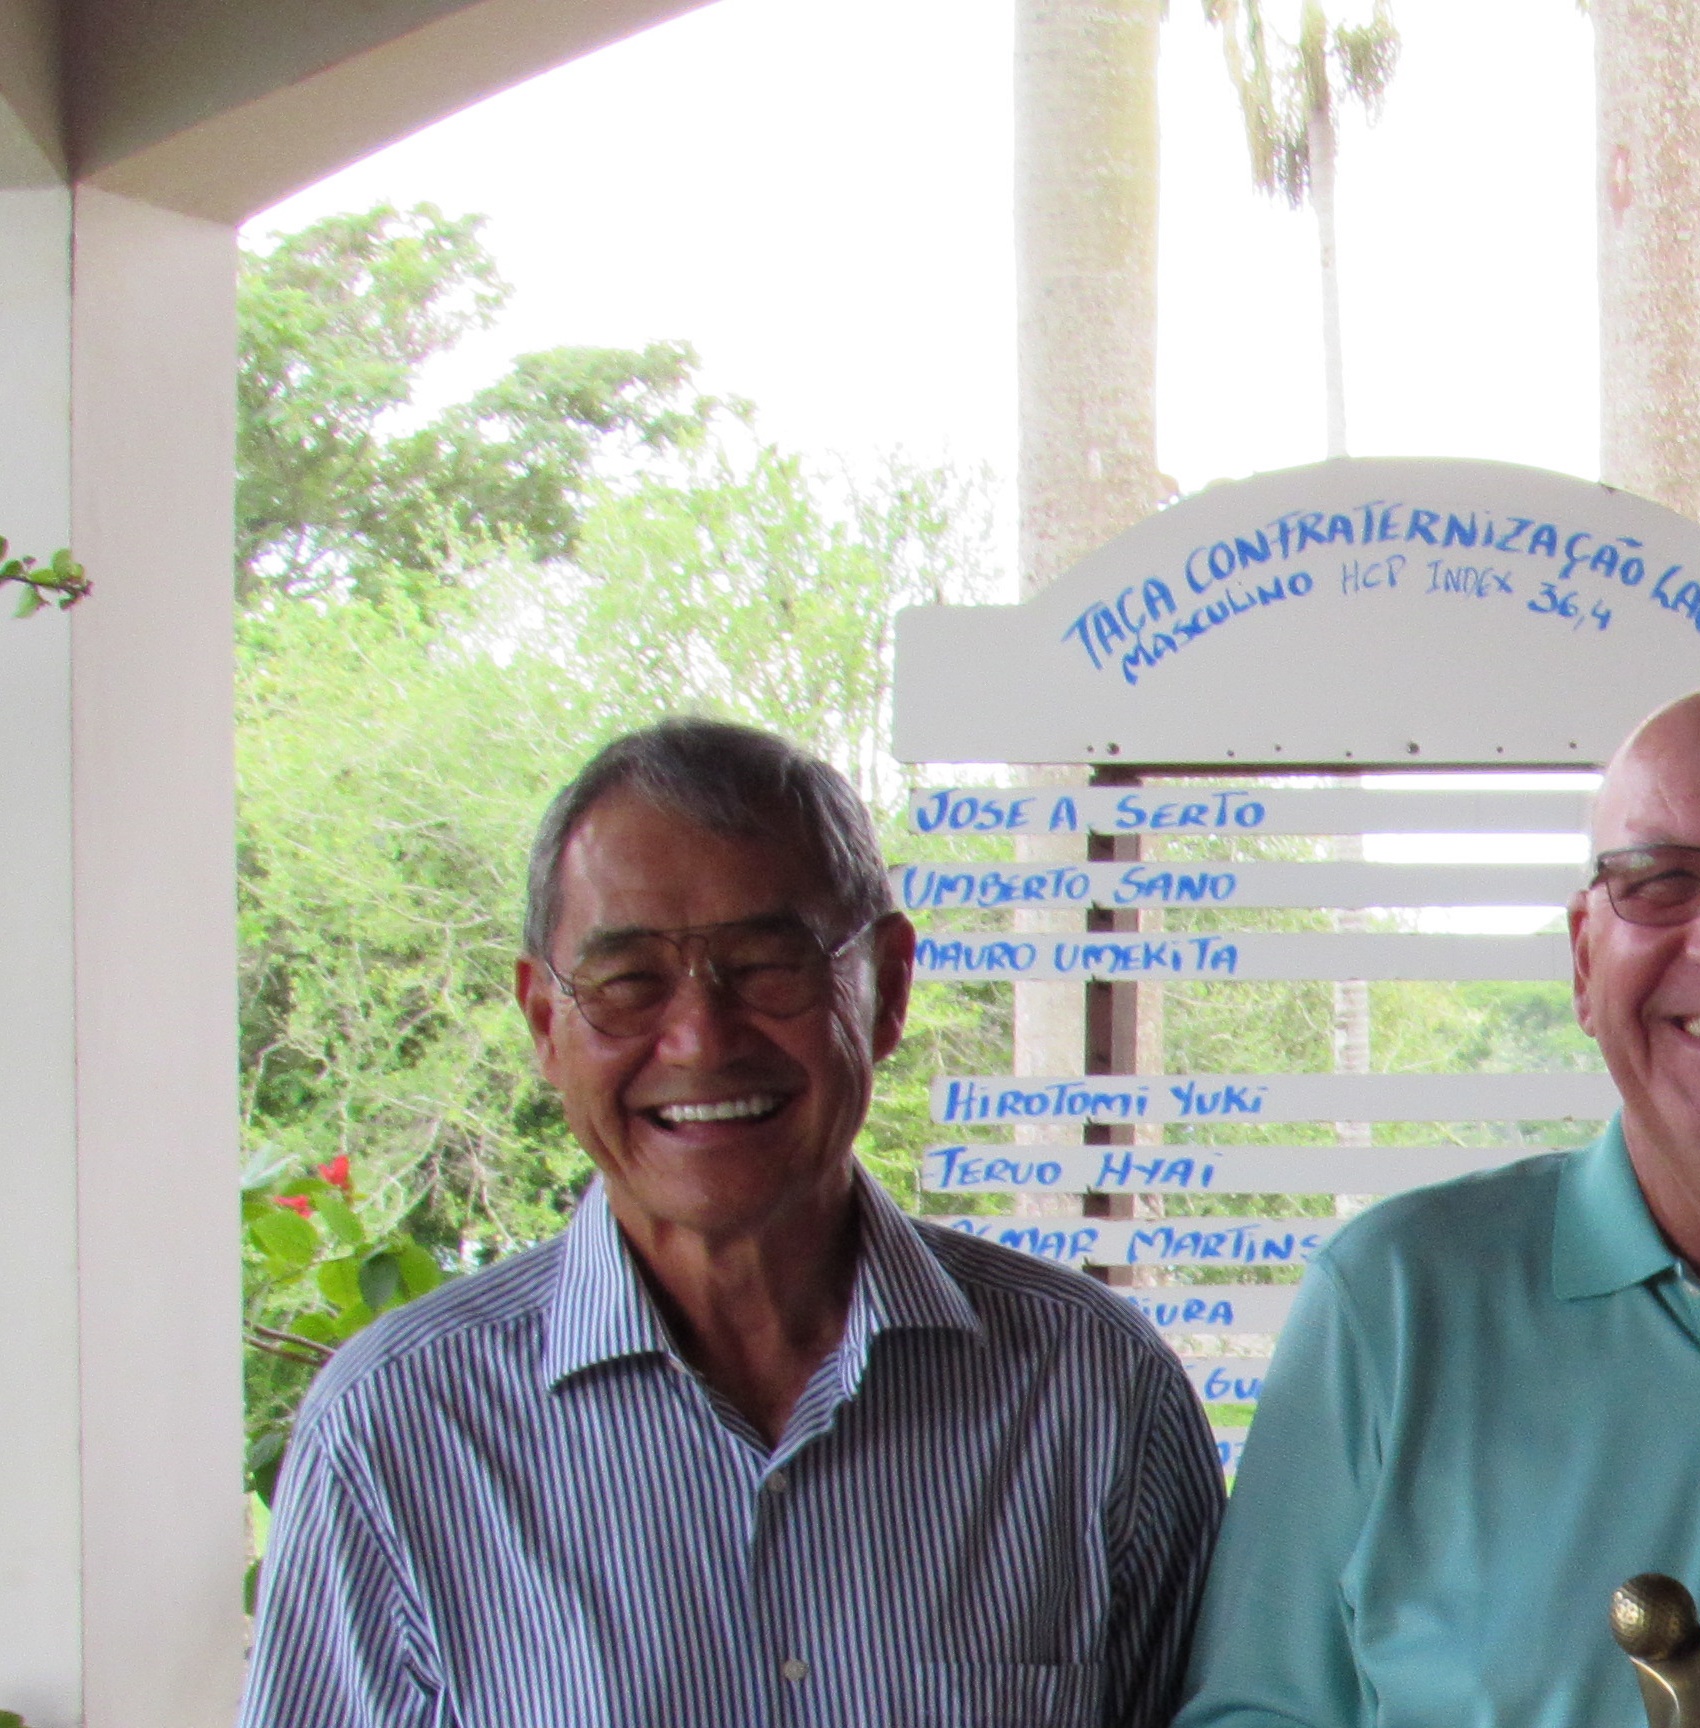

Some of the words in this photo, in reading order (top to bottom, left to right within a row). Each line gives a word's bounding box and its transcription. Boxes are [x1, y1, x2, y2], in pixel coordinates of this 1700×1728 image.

[1341, 553, 1406, 596] HCP
[1426, 558, 1512, 598] INDEX
[1527, 580, 1612, 631] 36,4
[916, 787, 1034, 832] JOSE
[1049, 797, 1078, 831] A
[1115, 790, 1266, 829] SERTO
[903, 866, 1091, 908] UMBERTO
[1114, 867, 1237, 903] SANO
[914, 938, 1036, 972] MAURO
